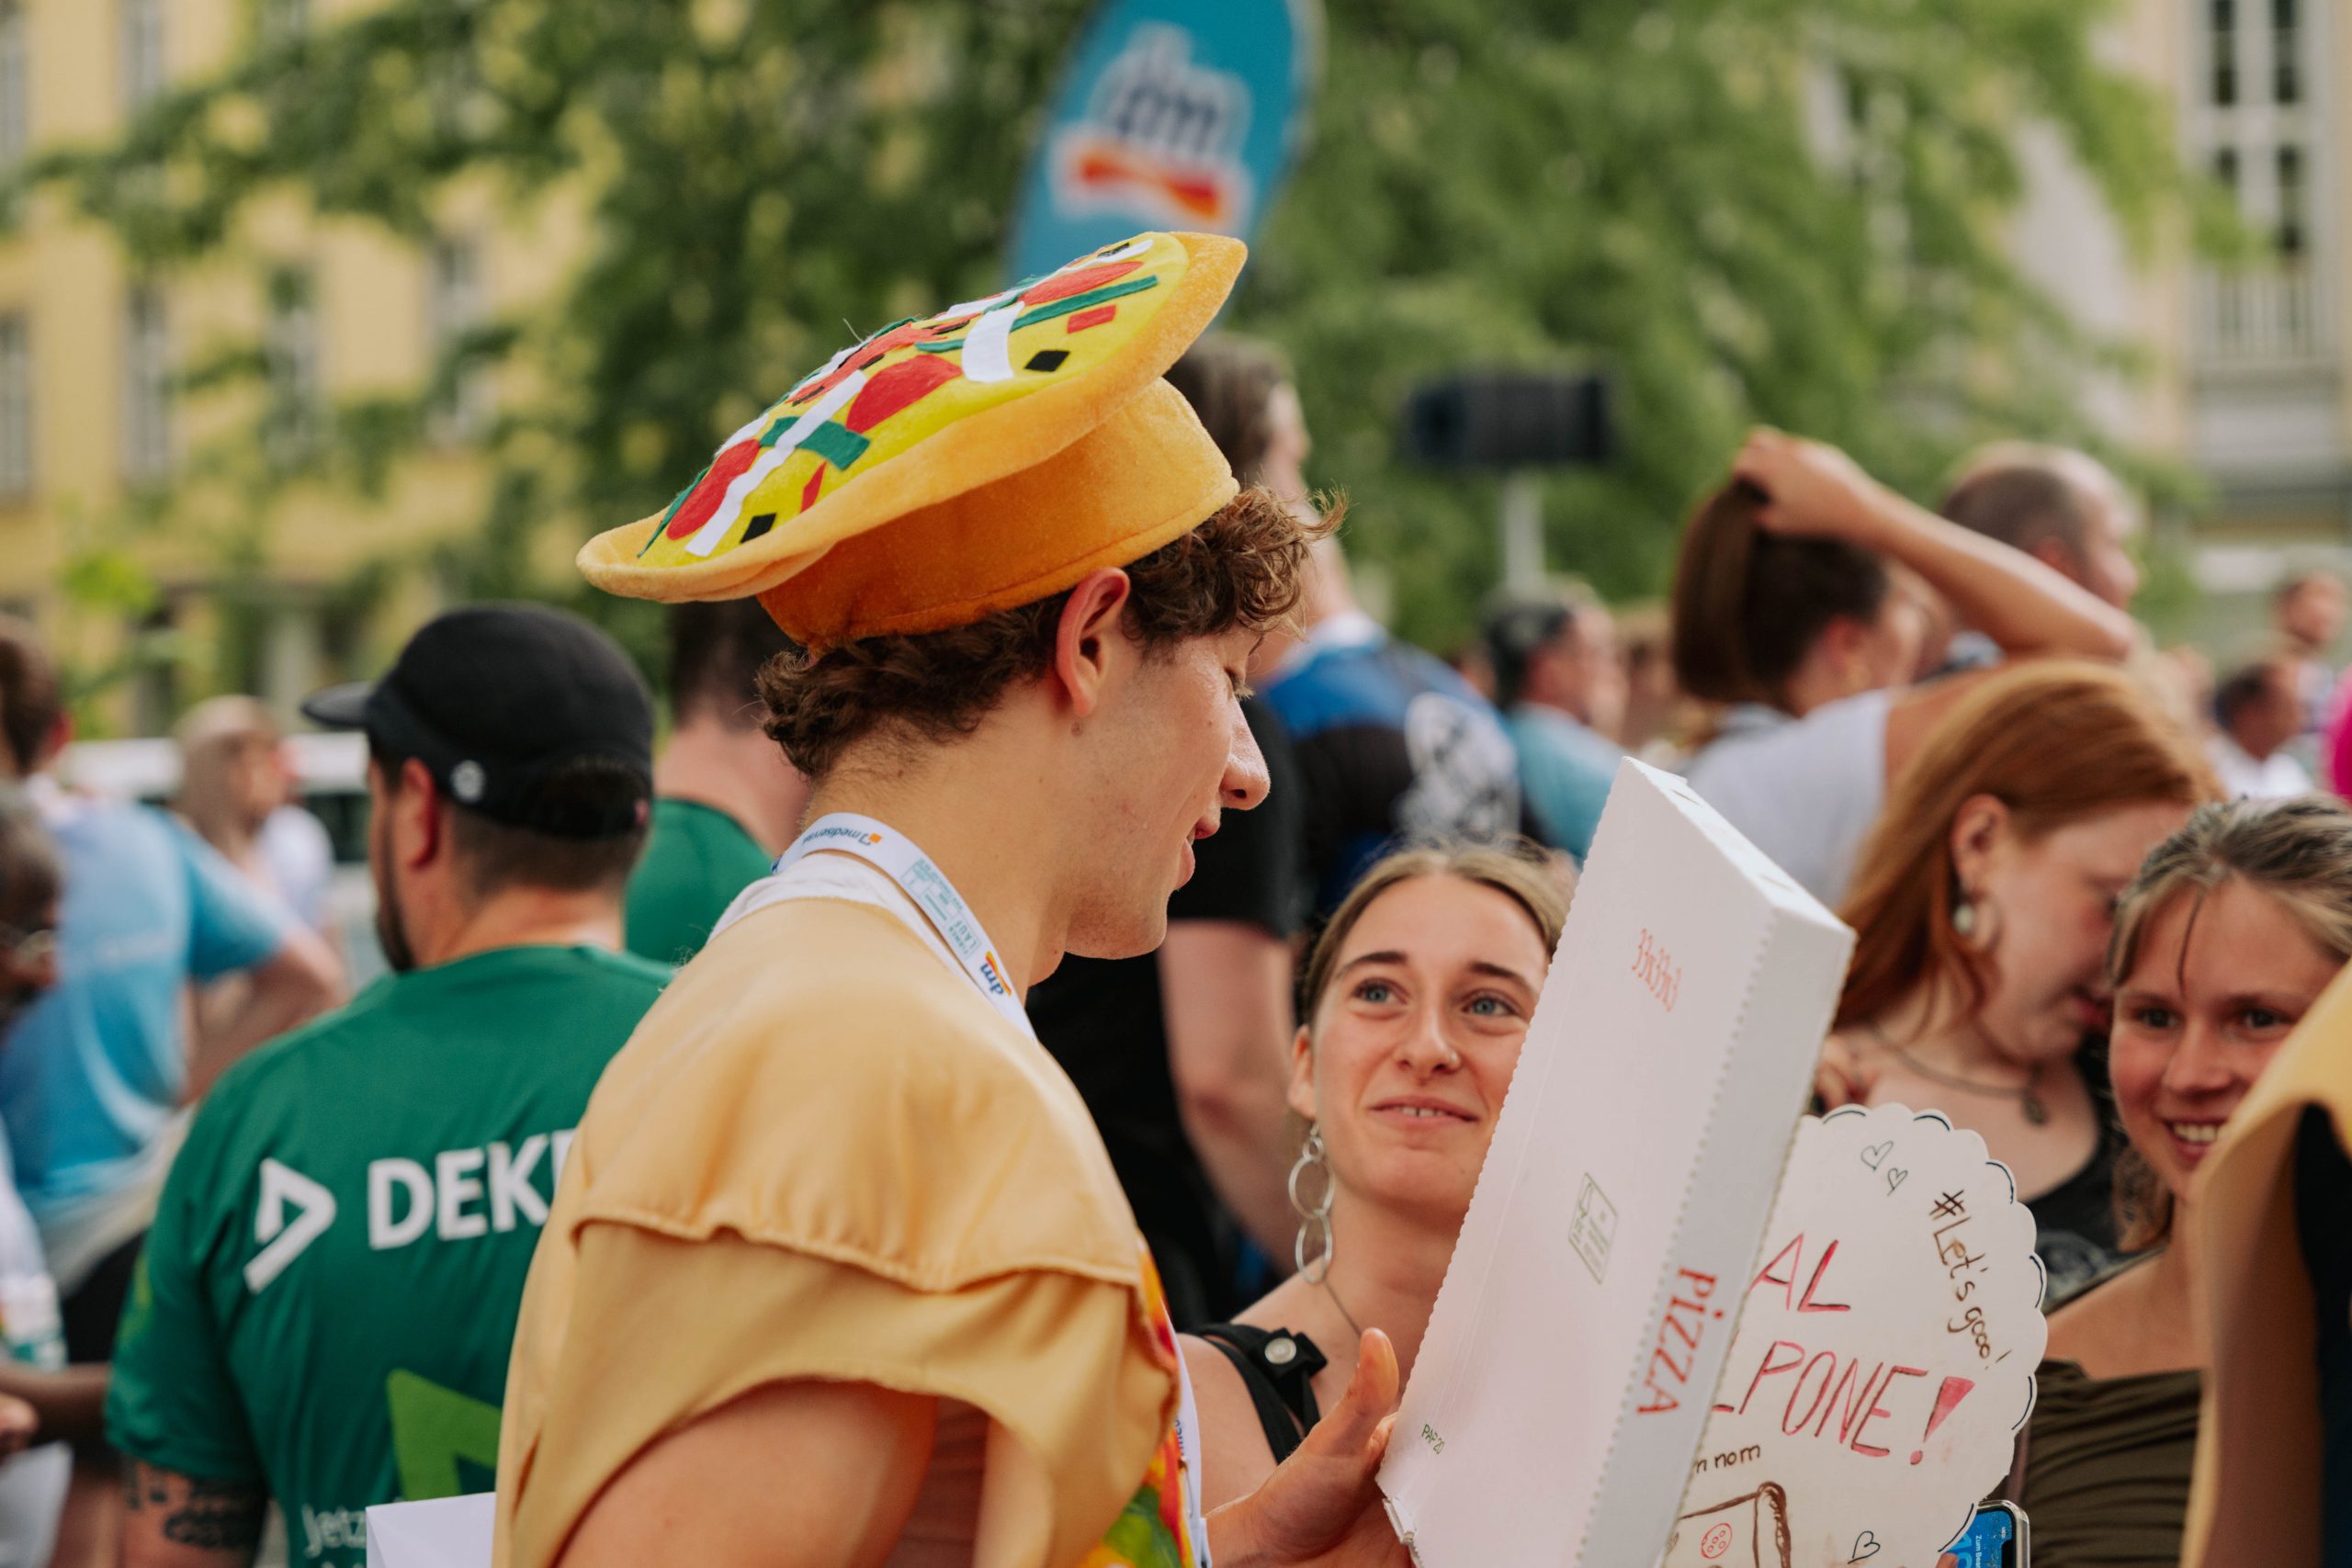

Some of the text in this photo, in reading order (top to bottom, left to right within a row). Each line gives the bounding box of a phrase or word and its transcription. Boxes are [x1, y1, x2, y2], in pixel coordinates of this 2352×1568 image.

[979, 962, 1004, 994] dm
[1745, 1232, 1851, 1312] AL
[1928, 1189, 1989, 1303] #Let's
[1712, 1339, 1976, 1466] PONE!
[1421, 1424, 1439, 1444] PAP
[1714, 1444, 1760, 1469] nom
